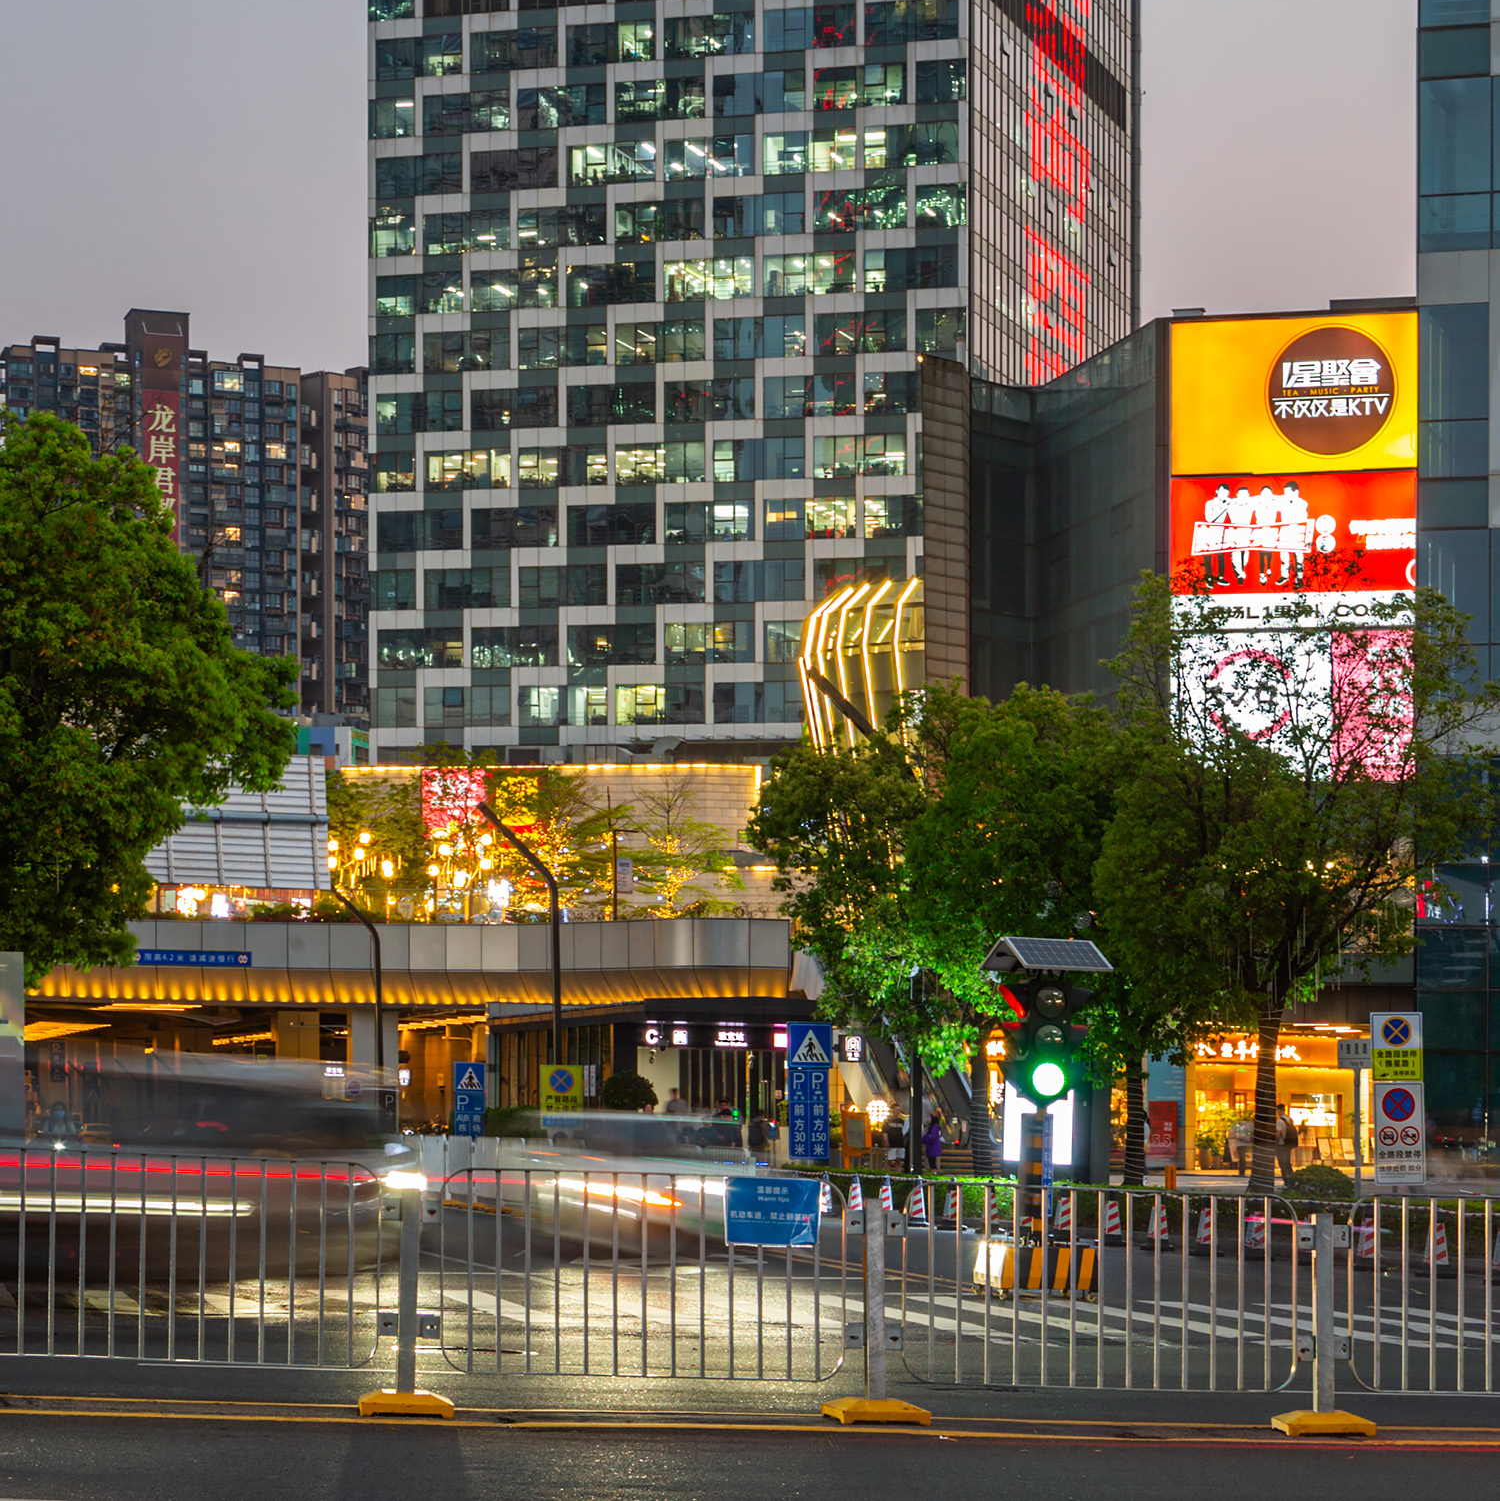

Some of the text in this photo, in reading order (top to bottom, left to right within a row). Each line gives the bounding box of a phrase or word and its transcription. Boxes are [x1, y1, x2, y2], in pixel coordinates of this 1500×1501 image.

[1310, 387, 1339, 395] MUSIC
[1350, 386, 1379, 394] PARTY
[1274, 397, 1389, 419] 不仅仅是KTV
[645, 1029, 659, 1045] C
[1377, 1050, 1417, 1058] 全路段禁停
[1379, 1150, 1421, 1159] 全路段禁停
[757, 1186, 789, 1195] 温馨提示
